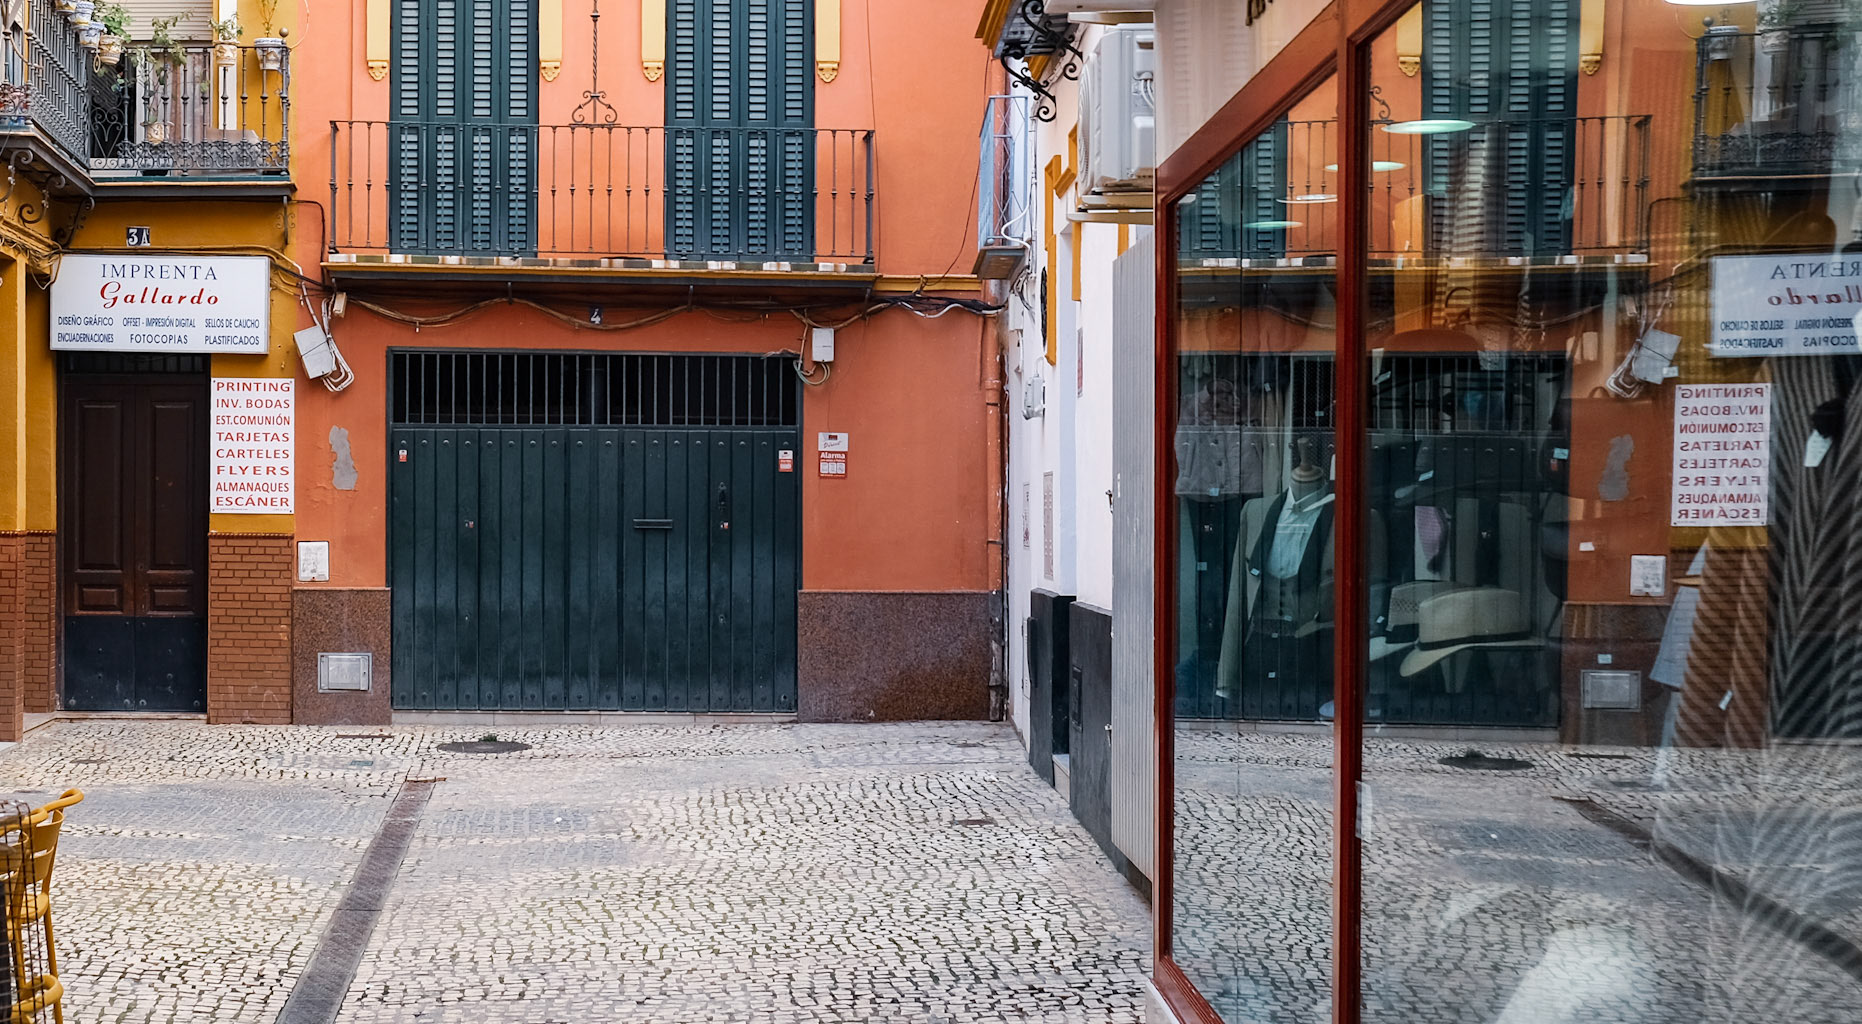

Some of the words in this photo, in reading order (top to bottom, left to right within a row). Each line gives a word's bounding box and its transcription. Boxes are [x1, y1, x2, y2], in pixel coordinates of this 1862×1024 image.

[101, 263, 218, 281] IMPRENTA
[100, 281, 219, 309] Gallardo
[58, 314, 82, 326] DISEÑO
[83, 314, 114, 326] GRÁFICO
[122, 317, 141, 327] OFFSET
[145, 315, 175, 327] IMPRESIÓN
[175, 318, 196, 328] DIGITAL
[590, 308, 601, 324] 4
[204, 318, 225, 328] SELLOS
[225, 318, 233, 328] DE
[233, 318, 260, 329] CAUCHO
[57, 332, 114, 343] ENCUADERNACIONES
[130, 333, 188, 345] FOTOCOPIAS
[204, 335, 260, 346] PLASTIFICADOS
[216, 381, 290, 392] PRINTING
[216, 398, 242, 409] INV.
[246, 399, 290, 409] BODAS
[216, 432, 290, 442] TARJETAS
[216, 448, 290, 459] CARTELES
[217, 465, 290, 476] FLYERS
[216, 482, 290, 493] ALMANAQUES
[216, 494, 290, 507] ESCÁNER
